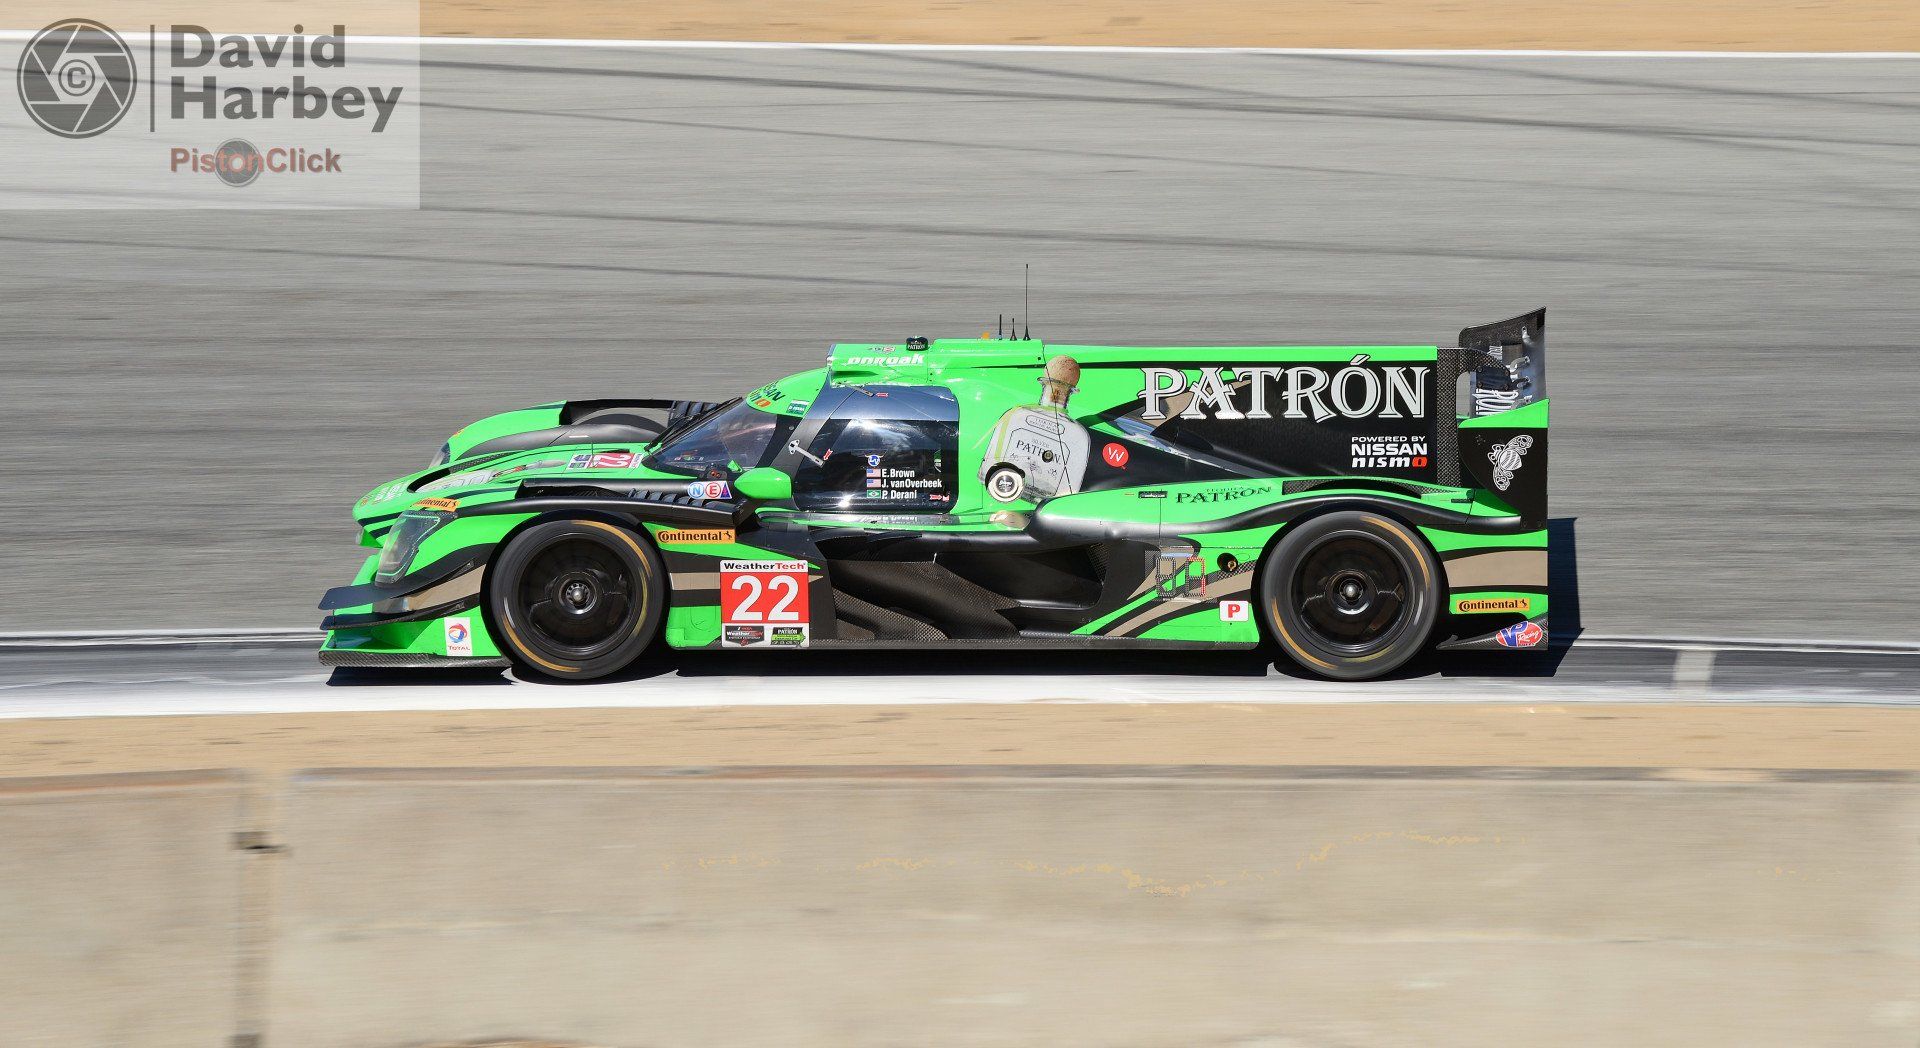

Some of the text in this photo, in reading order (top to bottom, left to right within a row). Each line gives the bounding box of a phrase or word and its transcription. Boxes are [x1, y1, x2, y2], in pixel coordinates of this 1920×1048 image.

[1137, 354, 1430, 423] PATRÓN
[1351, 443, 1428, 456] NISSAN
[890, 468, 915, 478] Brown
[881, 479, 889, 488] J.
[890, 489, 917, 499] Derani
[657, 530, 722, 543] Continental
[723, 562, 804, 570] WeatherTech
[731, 574, 799, 621] 22
[1227, 603, 1241, 618] P
[1458, 599, 1518, 612] Continental
